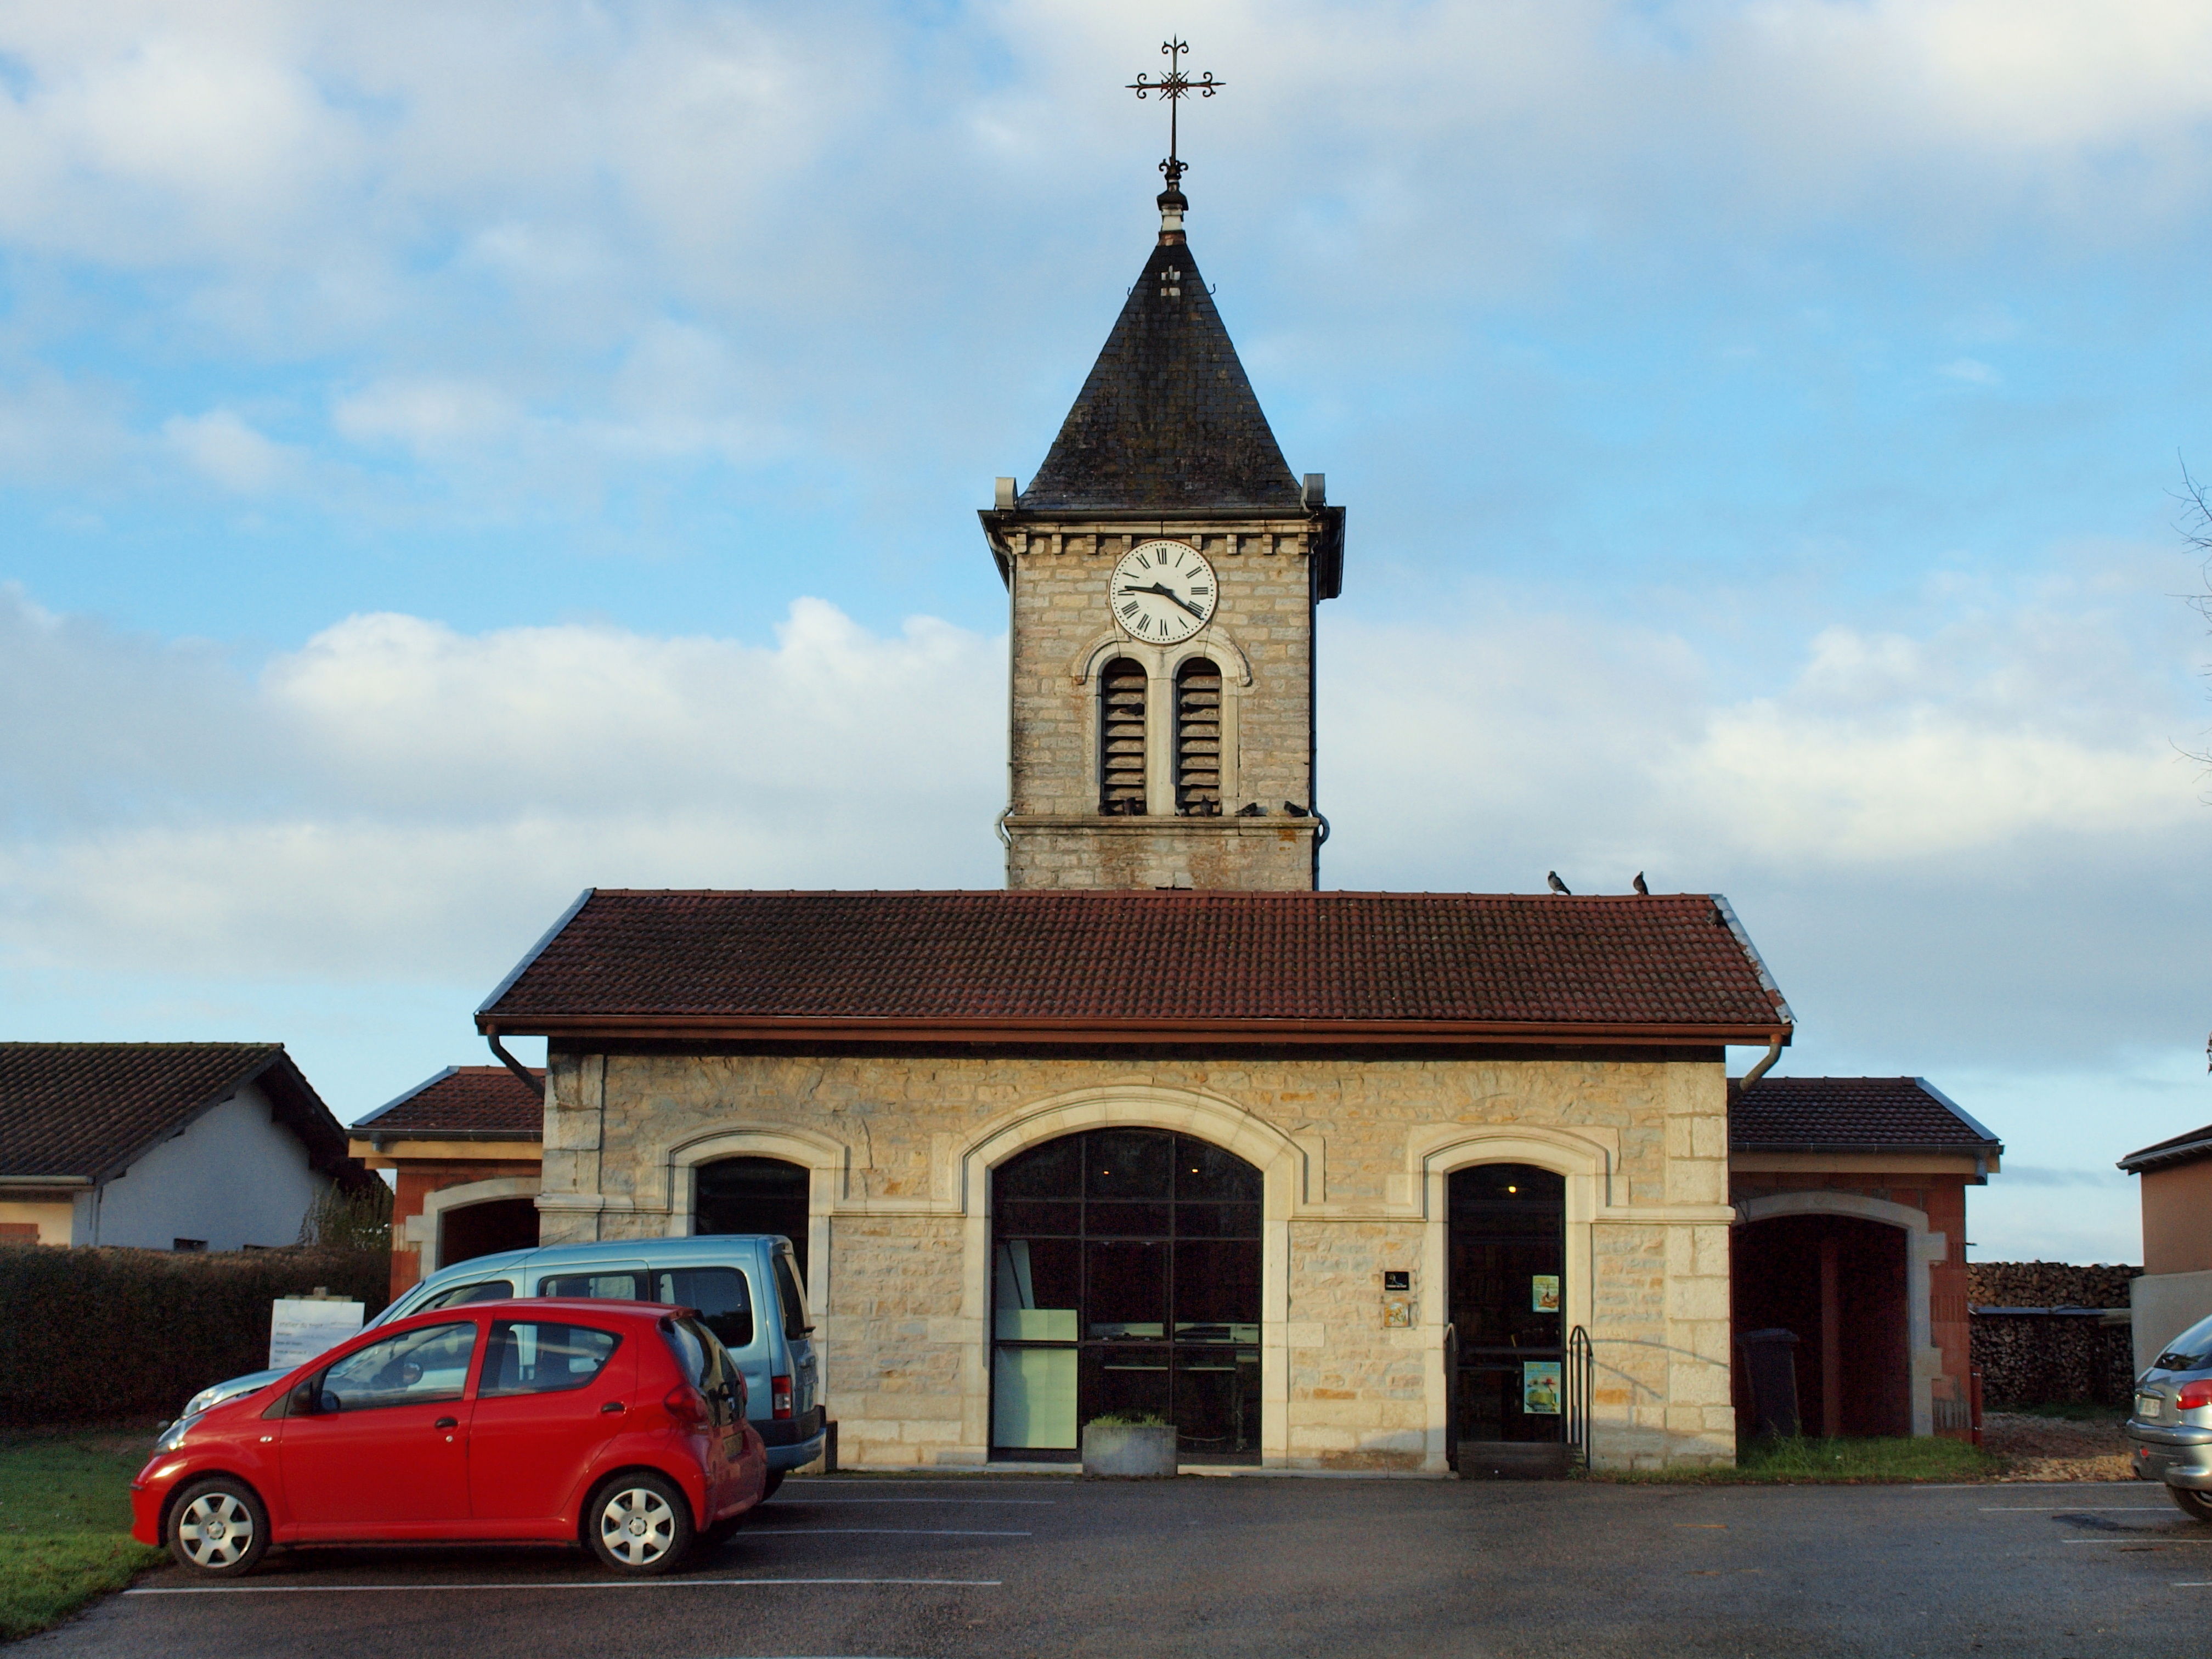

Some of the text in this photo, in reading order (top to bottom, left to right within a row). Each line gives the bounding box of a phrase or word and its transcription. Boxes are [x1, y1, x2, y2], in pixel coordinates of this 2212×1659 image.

[1156, 548, 1167, 565] XII
[1186, 566, 1202, 579] II
[1191, 587, 1208, 595] III
